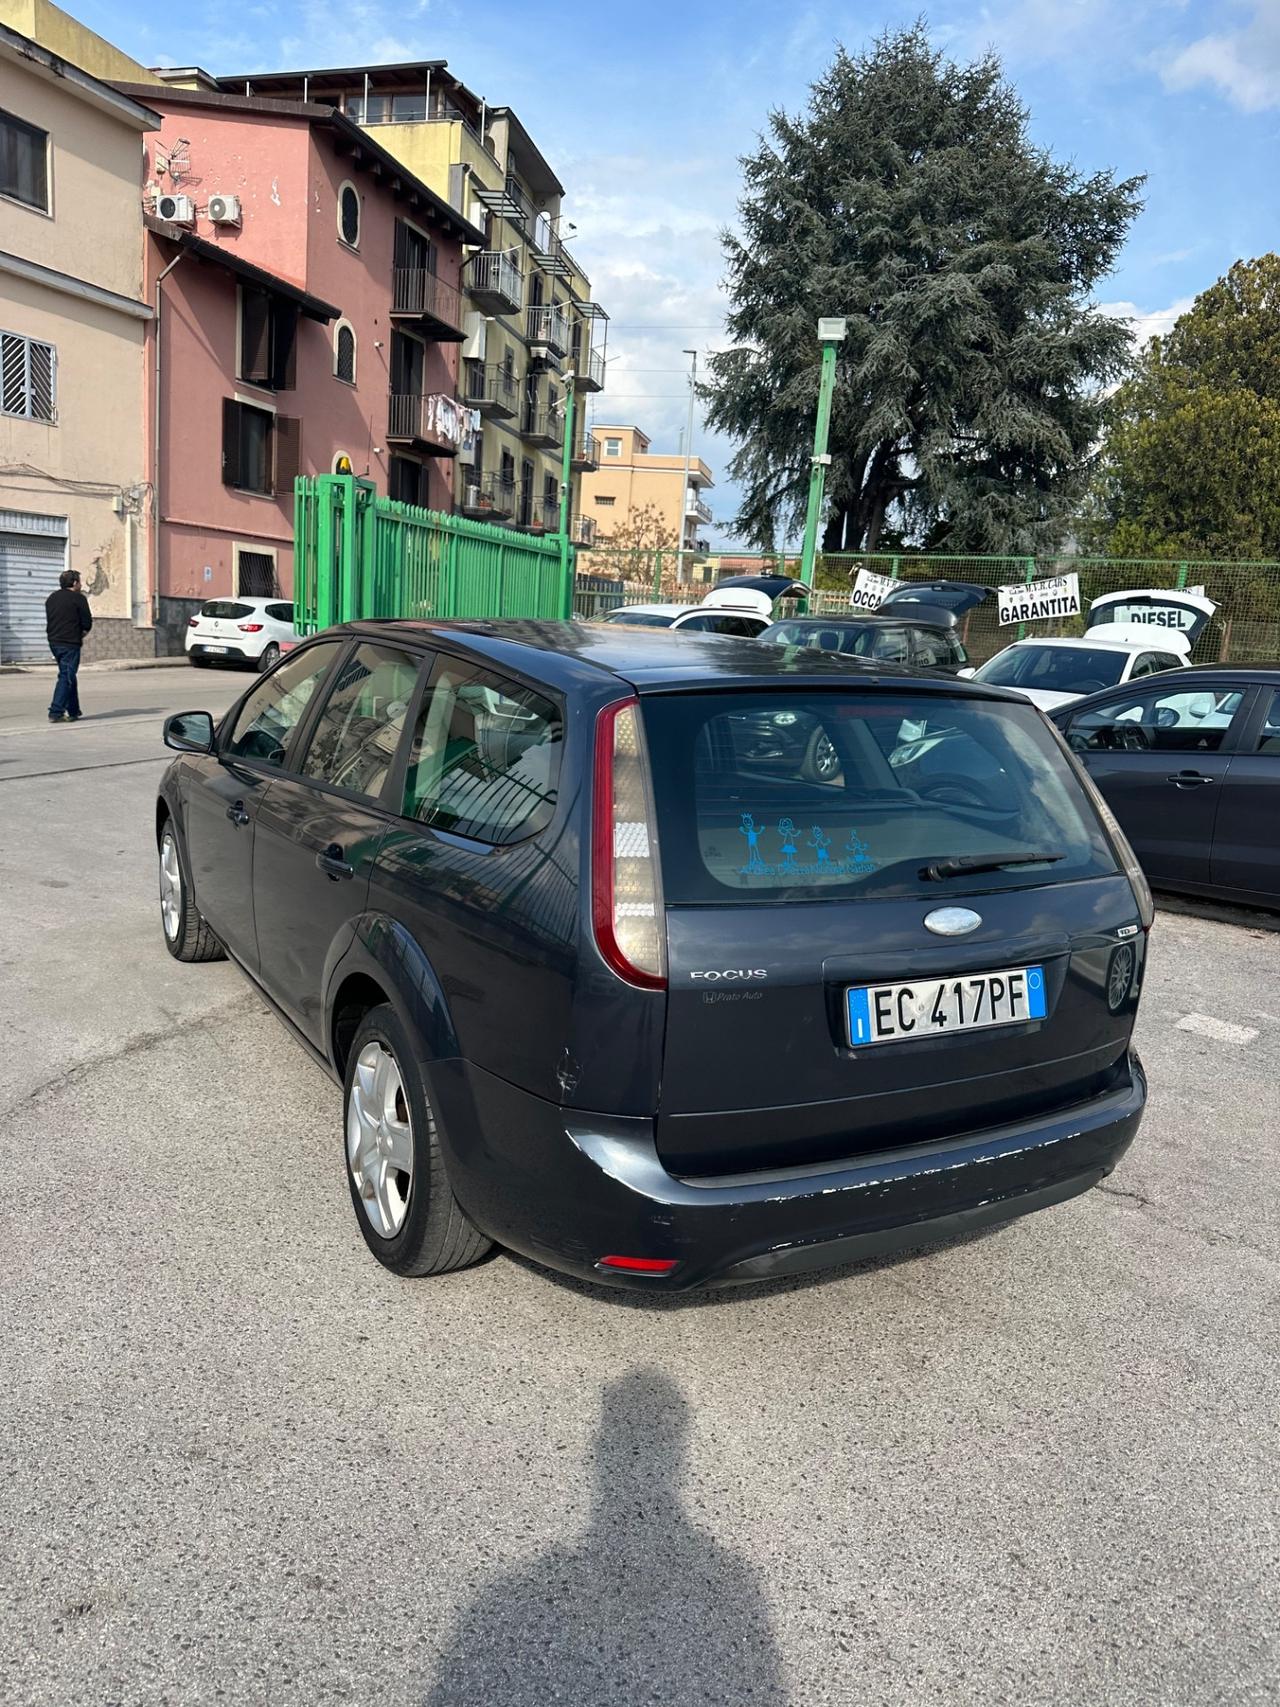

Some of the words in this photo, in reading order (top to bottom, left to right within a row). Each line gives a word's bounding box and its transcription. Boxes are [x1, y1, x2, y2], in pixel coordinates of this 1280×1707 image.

[1000, 595, 1078, 623] GARANTITA
[690, 968, 768, 981] FOCUS
[874, 988, 916, 1036] EC
[931, 974, 1023, 1027] 417PF
